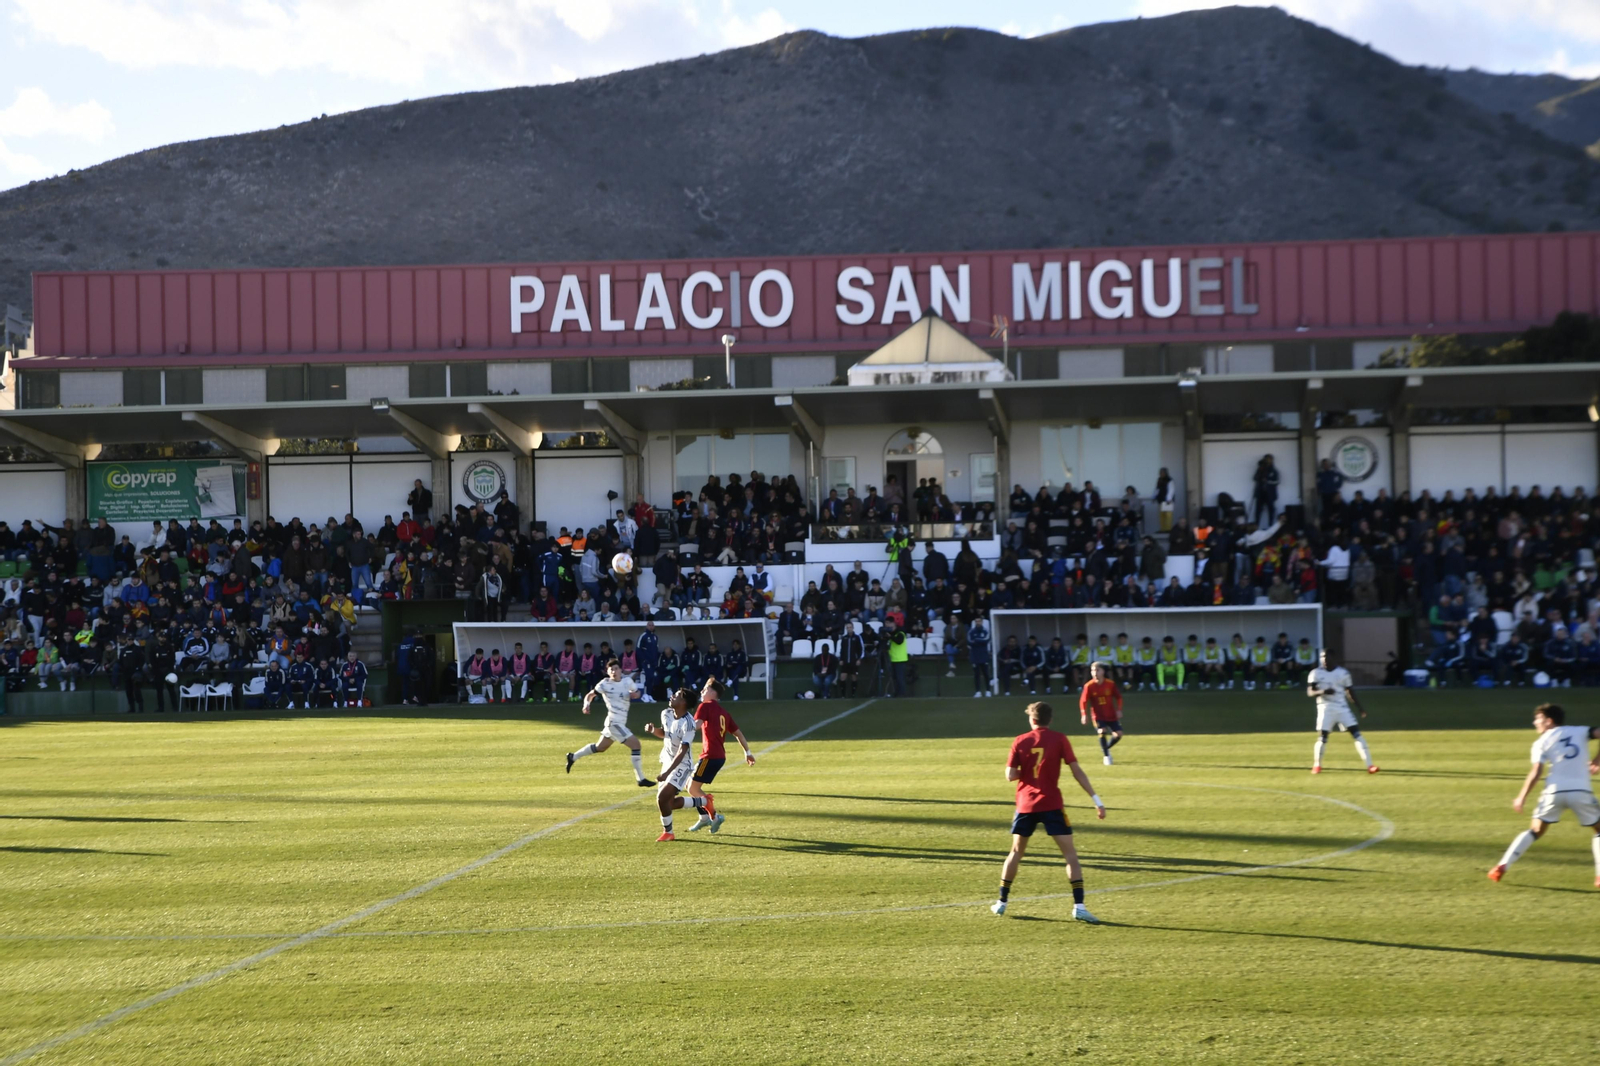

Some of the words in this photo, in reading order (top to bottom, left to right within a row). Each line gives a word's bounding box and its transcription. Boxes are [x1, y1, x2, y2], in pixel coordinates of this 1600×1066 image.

[510, 268, 794, 333] PALACIO
[835, 263, 971, 325] SAN
[1012, 256, 1260, 320] MIGUEL
[111, 471, 177, 489] copyrap
[719, 715, 726, 737] 9
[1559, 736, 1580, 759] 3
[675, 768, 683, 778] 5
[1030, 747, 1044, 778] 7
